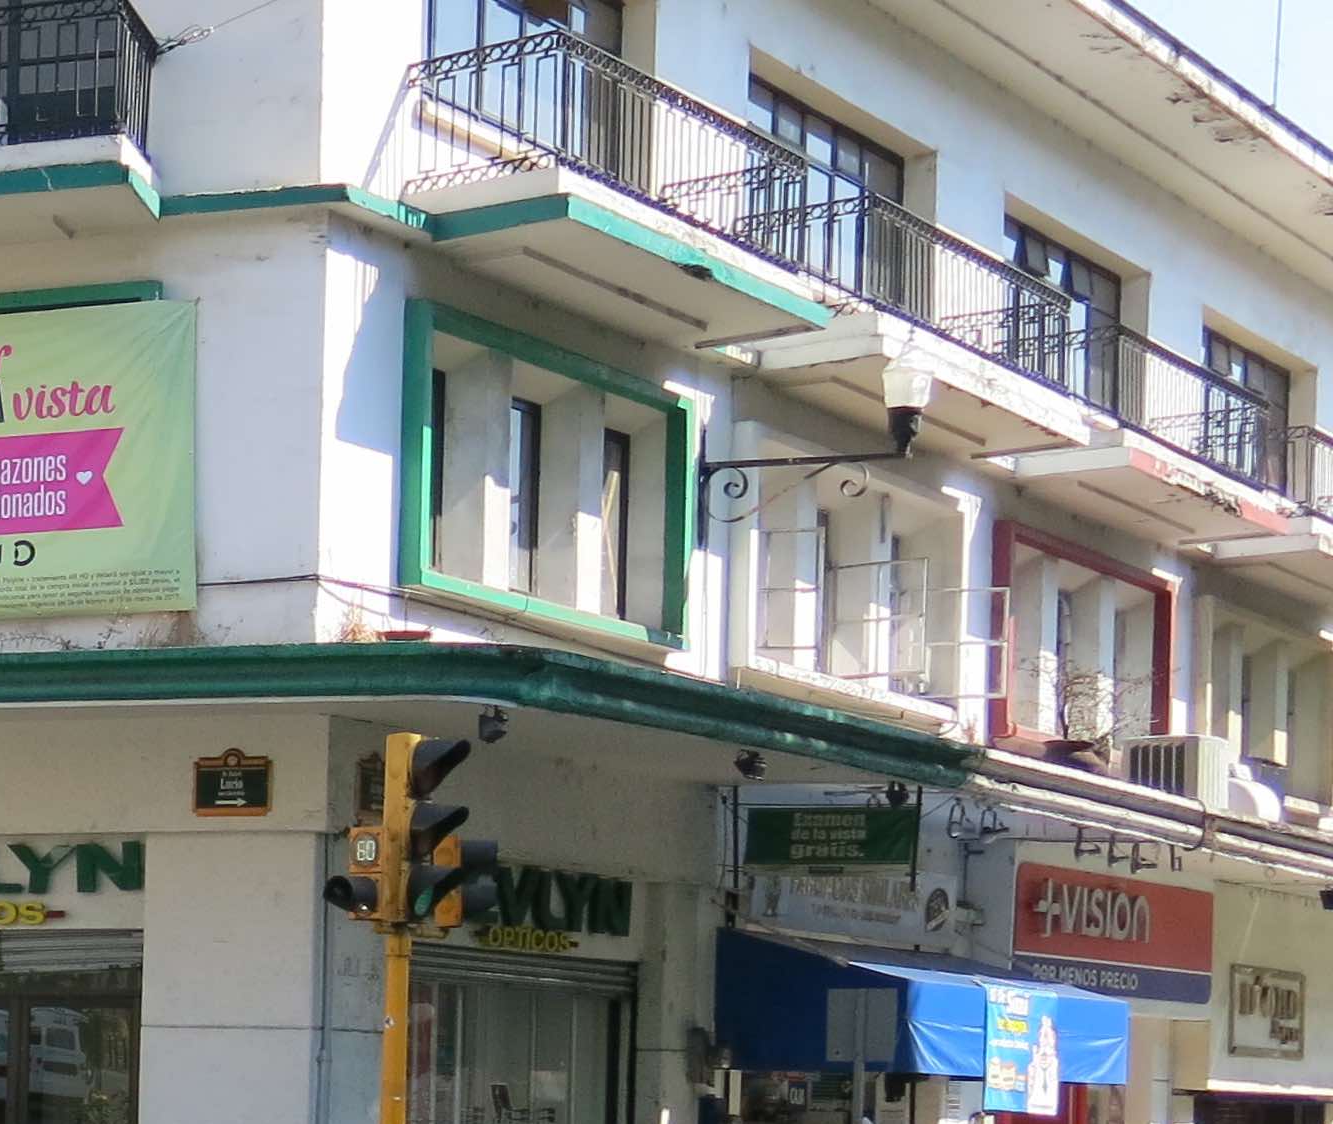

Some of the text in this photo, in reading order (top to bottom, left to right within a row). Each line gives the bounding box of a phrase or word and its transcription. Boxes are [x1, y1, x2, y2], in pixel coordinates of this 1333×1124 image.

[12, 384, 115, 420] vista
[793, 812, 867, 827] Examen
[791, 827, 867, 840] de la vista
[487, 865, 633, 937] VLYN
[488, 926, 571, 953] OPTICOS
[1033, 963, 1138, 991] POR MENOS PRECIO
